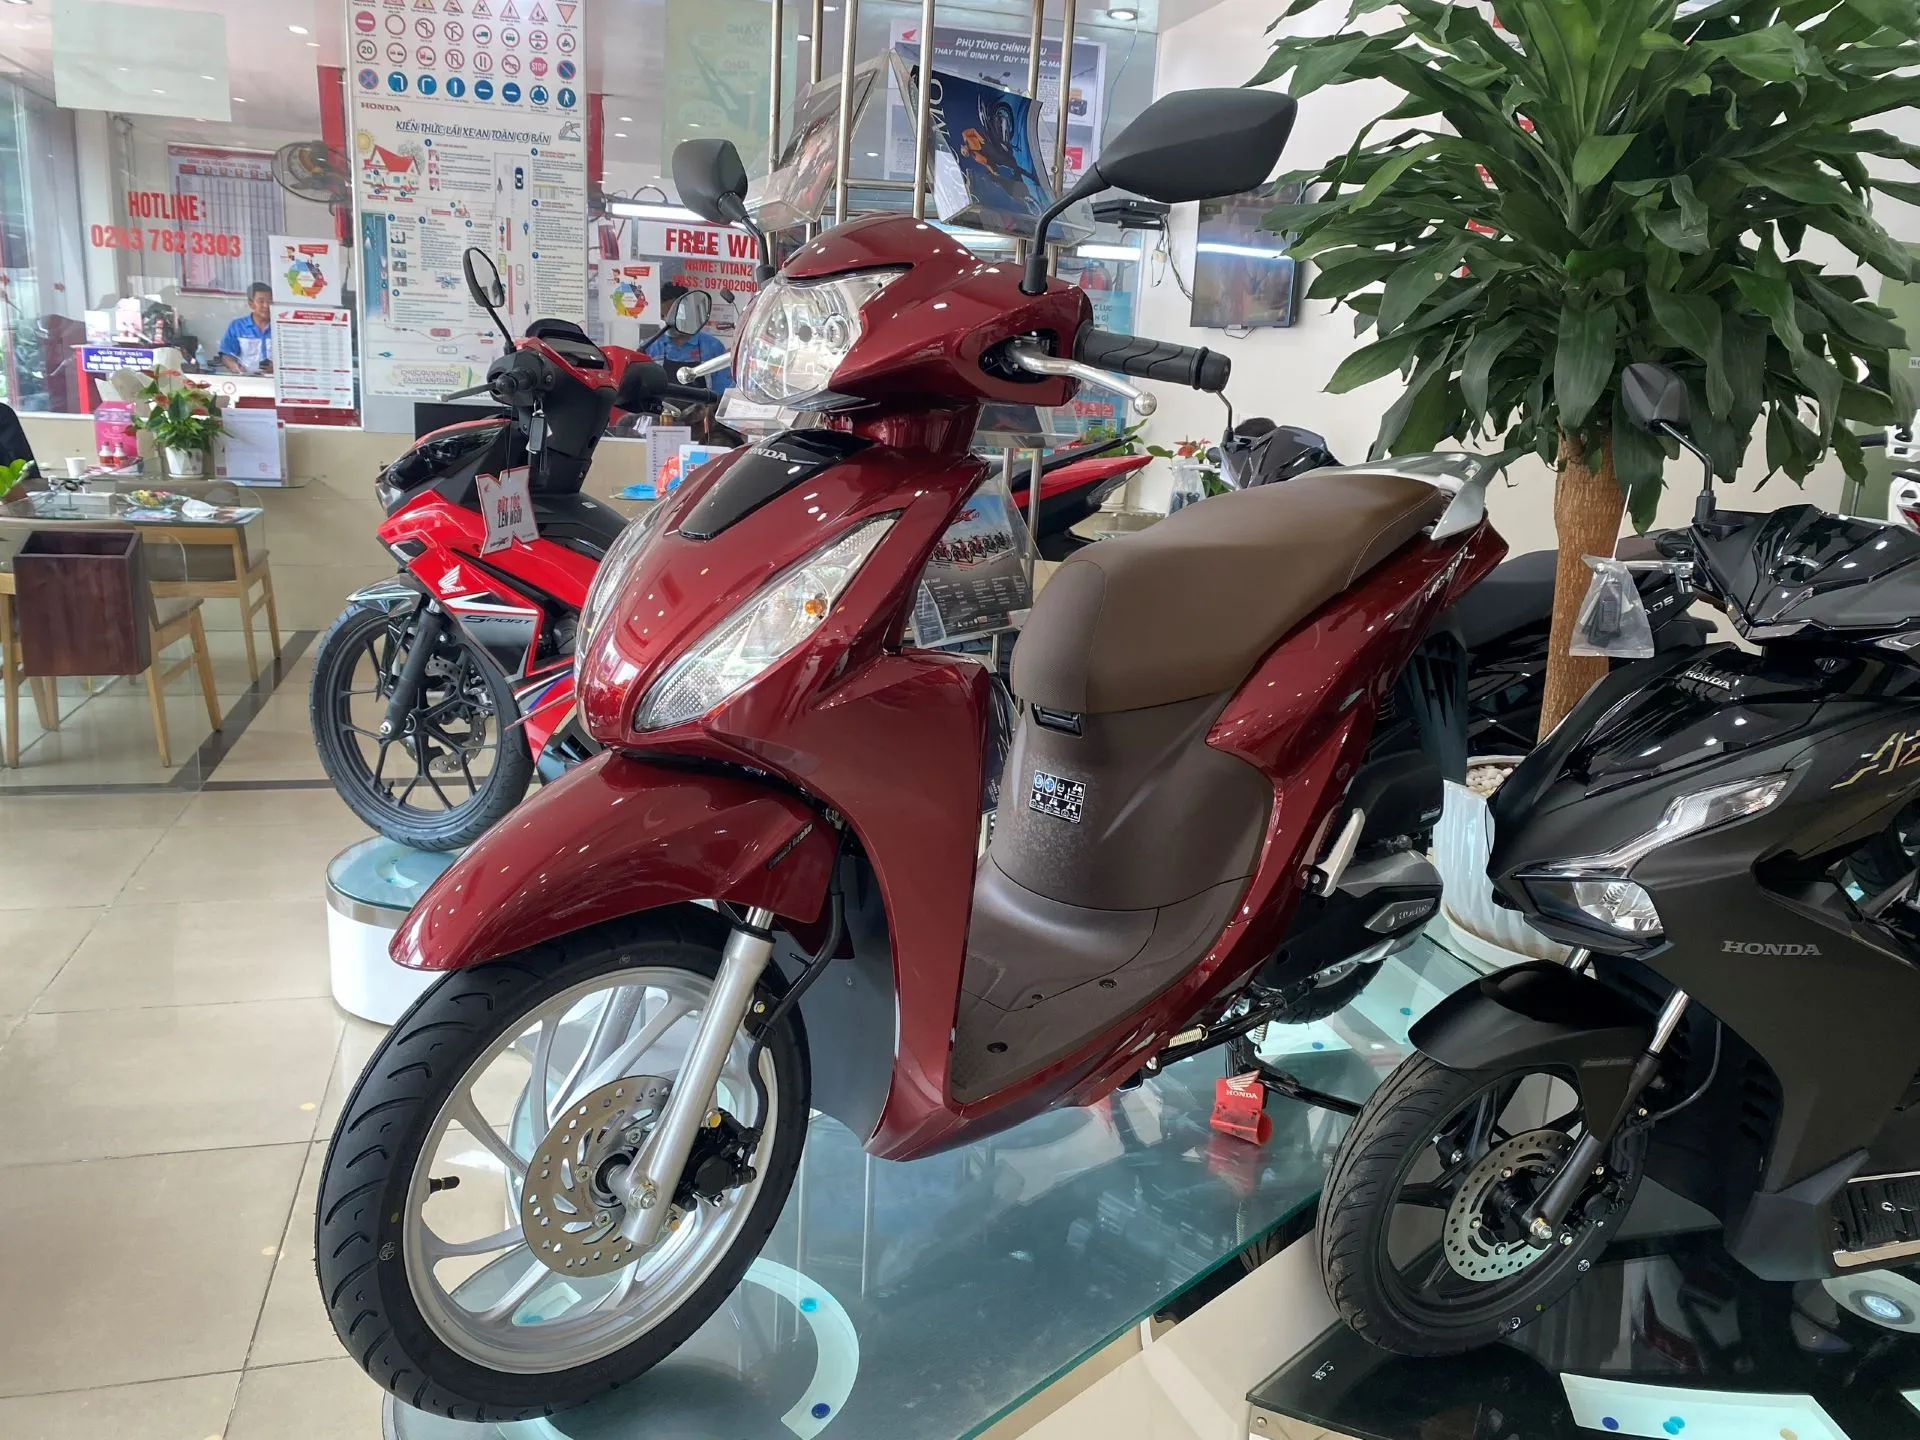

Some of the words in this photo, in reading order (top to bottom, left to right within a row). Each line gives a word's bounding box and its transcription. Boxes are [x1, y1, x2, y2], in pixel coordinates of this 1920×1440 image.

[361, 45, 373, 55] 20
[956, 37, 975, 50] PHỤ
[976, 37, 999, 50] TÙNG
[1000, 40, 1027, 55] CHÍNH
[934, 48, 954, 58] THAY
[1003, 55, 1019, 64] DUY
[531, 62, 547, 72] STOP
[360, 102, 401, 112] HONDA
[395, 118, 418, 132] KIẾN
[420, 122, 443, 135] THỨC
[446, 124, 461, 136] LÁI
[463, 127, 475, 138] XE
[475, 127, 489, 139] AN
[491, 127, 515, 141] TOÀN
[128, 191, 206, 221] HOTLINE:
[149, 229, 186, 255] 782
[665, 228, 719, 256] FREE
[727, 233, 760, 259] WI
[684, 258, 717, 274] NAME:
[720, 263, 753, 277] VITAN2
[704, 277, 759, 293] 097902090
[750, 448, 788, 462] ONDA
[440, 586, 467, 595] HONDA
[1685, 670, 1731, 689] HONDA
[1721, 940, 1823, 956] HONDA
[1226, 1090, 1258, 1099] HONDA
